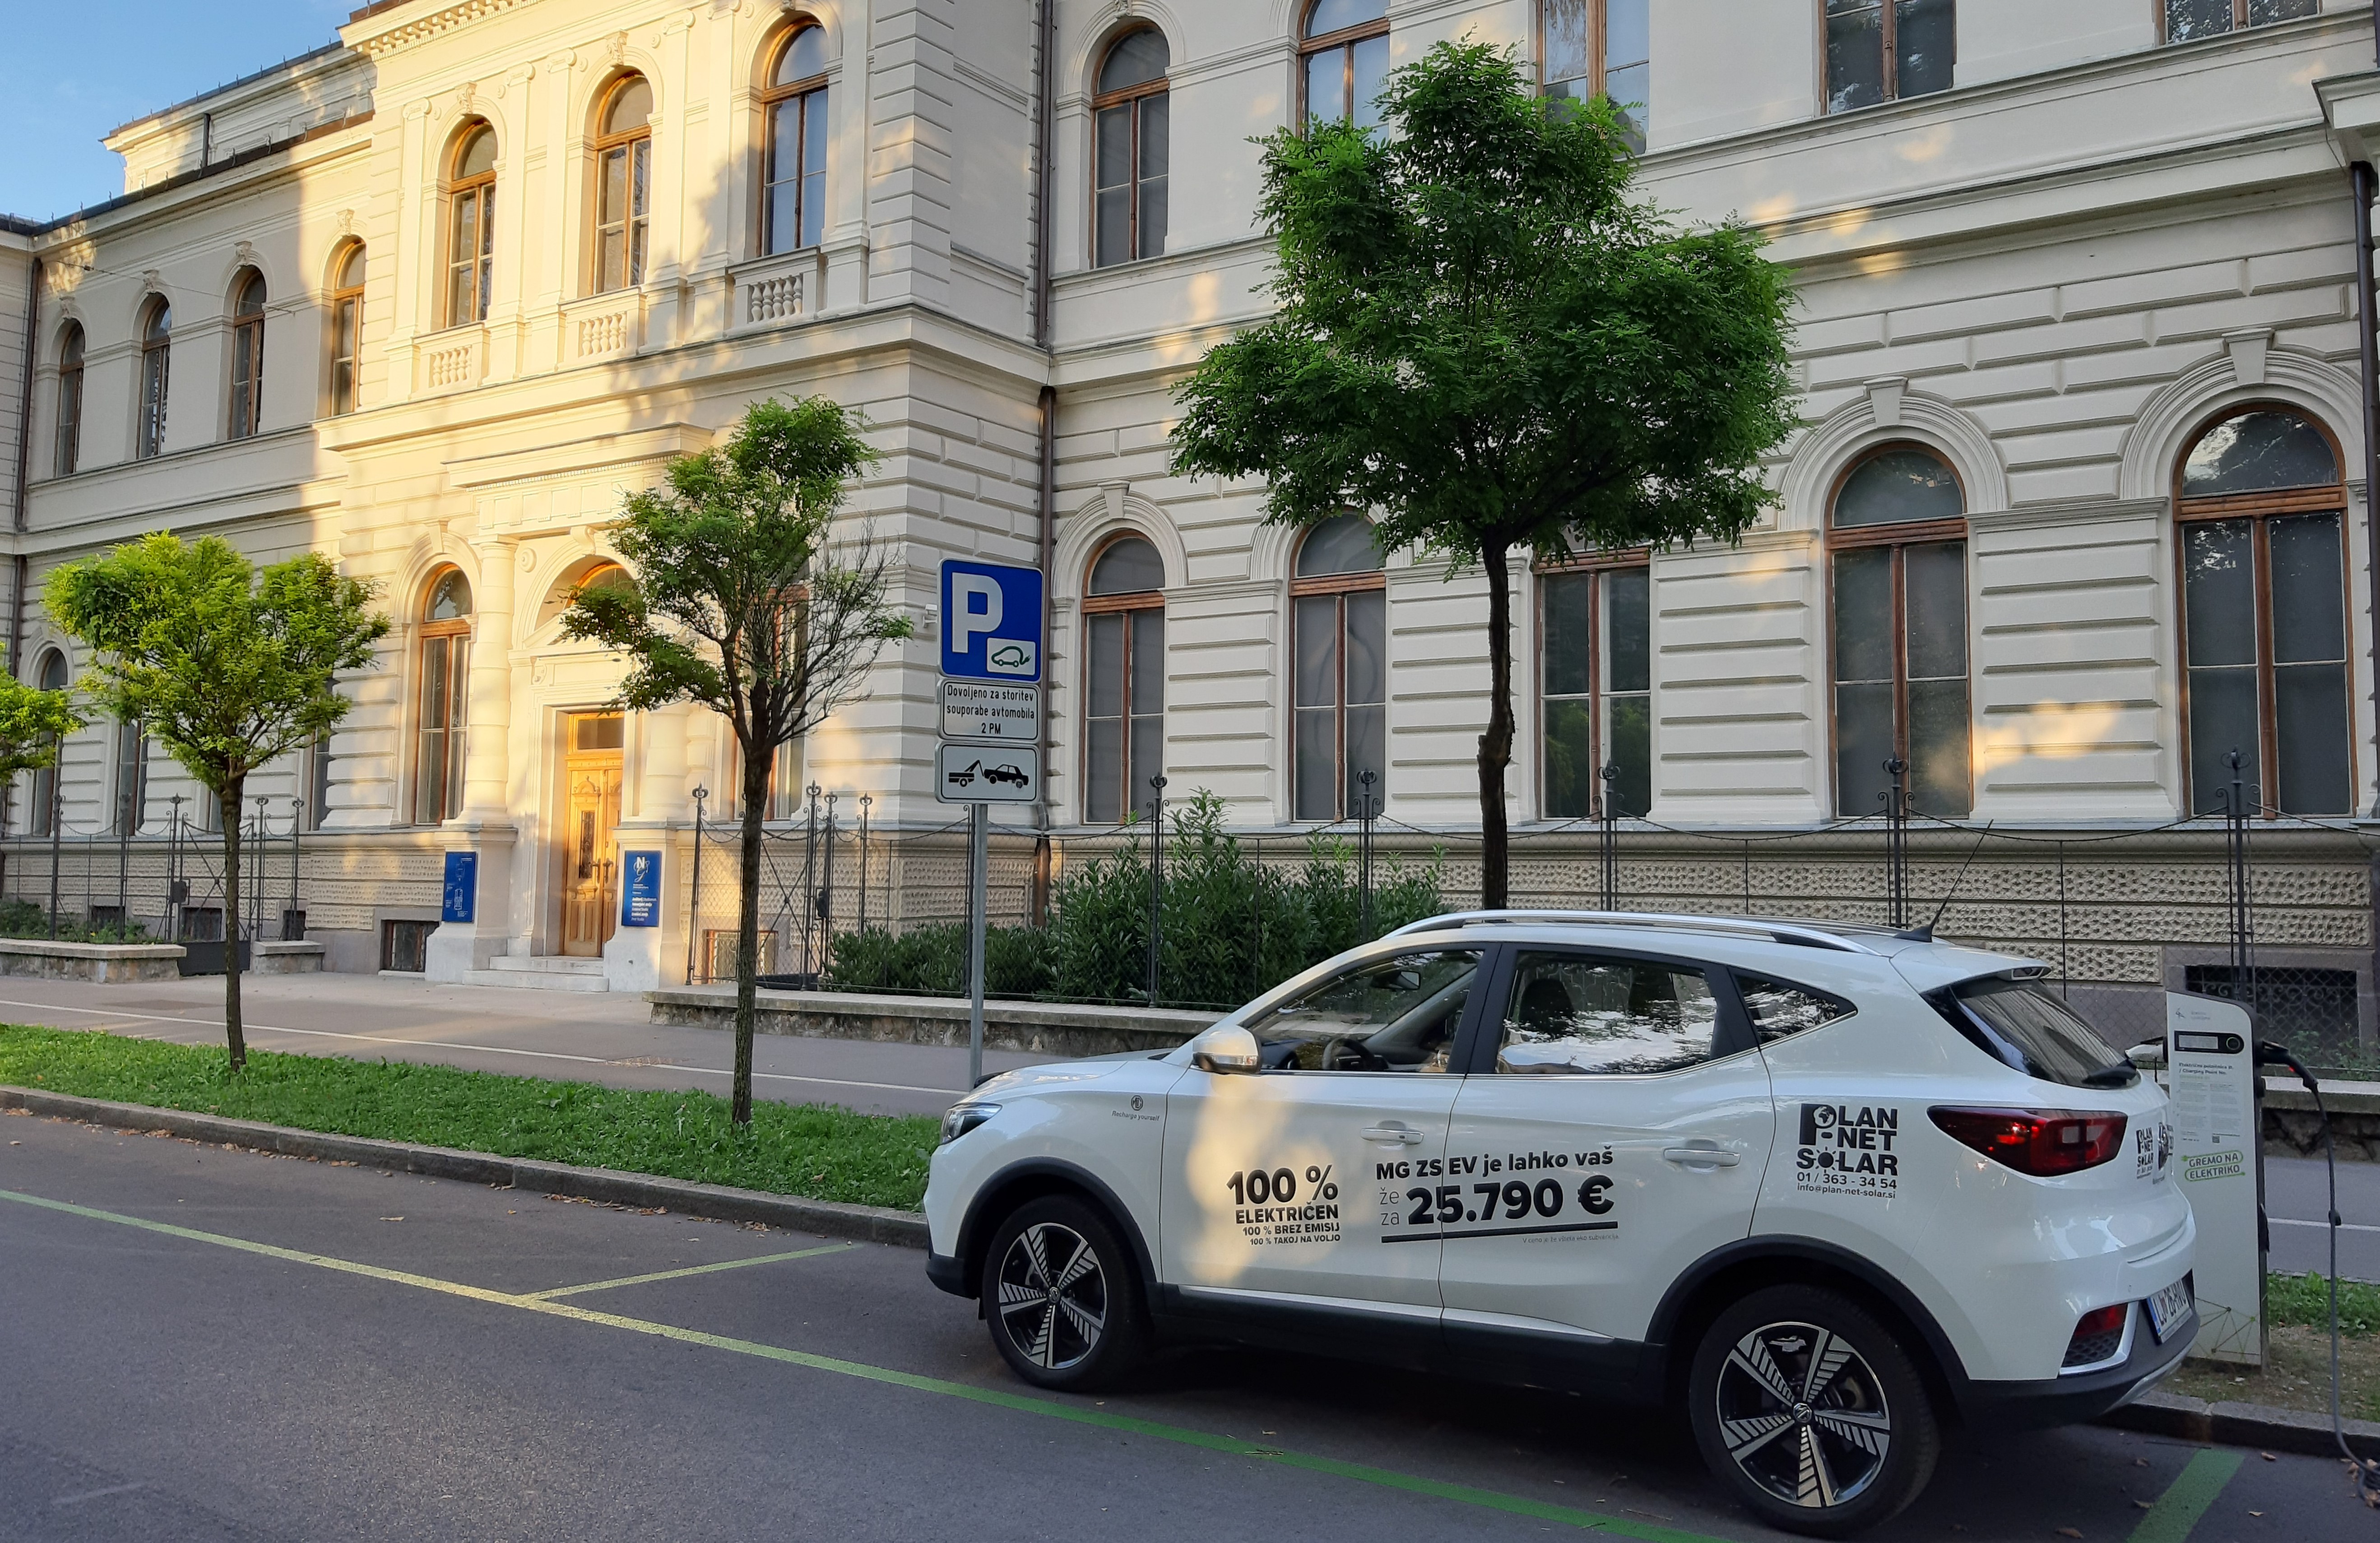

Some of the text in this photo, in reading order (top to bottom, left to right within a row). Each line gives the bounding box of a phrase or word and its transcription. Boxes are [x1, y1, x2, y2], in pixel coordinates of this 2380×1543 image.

[952, 572, 1003, 653] P
[948, 685, 1034, 701] Dovoljeno za storitev
[947, 704, 1034, 719] souporabe avtomobila
[981, 723, 1001, 734] 2 PM
[1112, 1111, 1137, 1120] Recharge
[1799, 1103, 1898, 1146] PLAN
[1376, 1146, 1613, 1180] MG ZS EV je lahko vaš
[2189, 1153, 2238, 1167] GREMO NA
[2190, 1165, 2240, 1179] ELEKTRIKO
[1226, 1164, 1338, 1205] 100 %
[1797, 1172, 1810, 1182] 01
[1814, 1173, 1819, 1183] /
[1823, 1174, 1847, 1185] 363
[1859, 1176, 1875, 1187] 34
[1880, 1178, 1897, 1189] 54
[1379, 1187, 1399, 1204] že
[1406, 1175, 1614, 1225] 25.790 €
[1235, 1201, 1338, 1224] ELEKTRIČEN
[1381, 1212, 1399, 1225] za
[1243, 1222, 1340, 1236] 100 % BREZ EMISIJ
